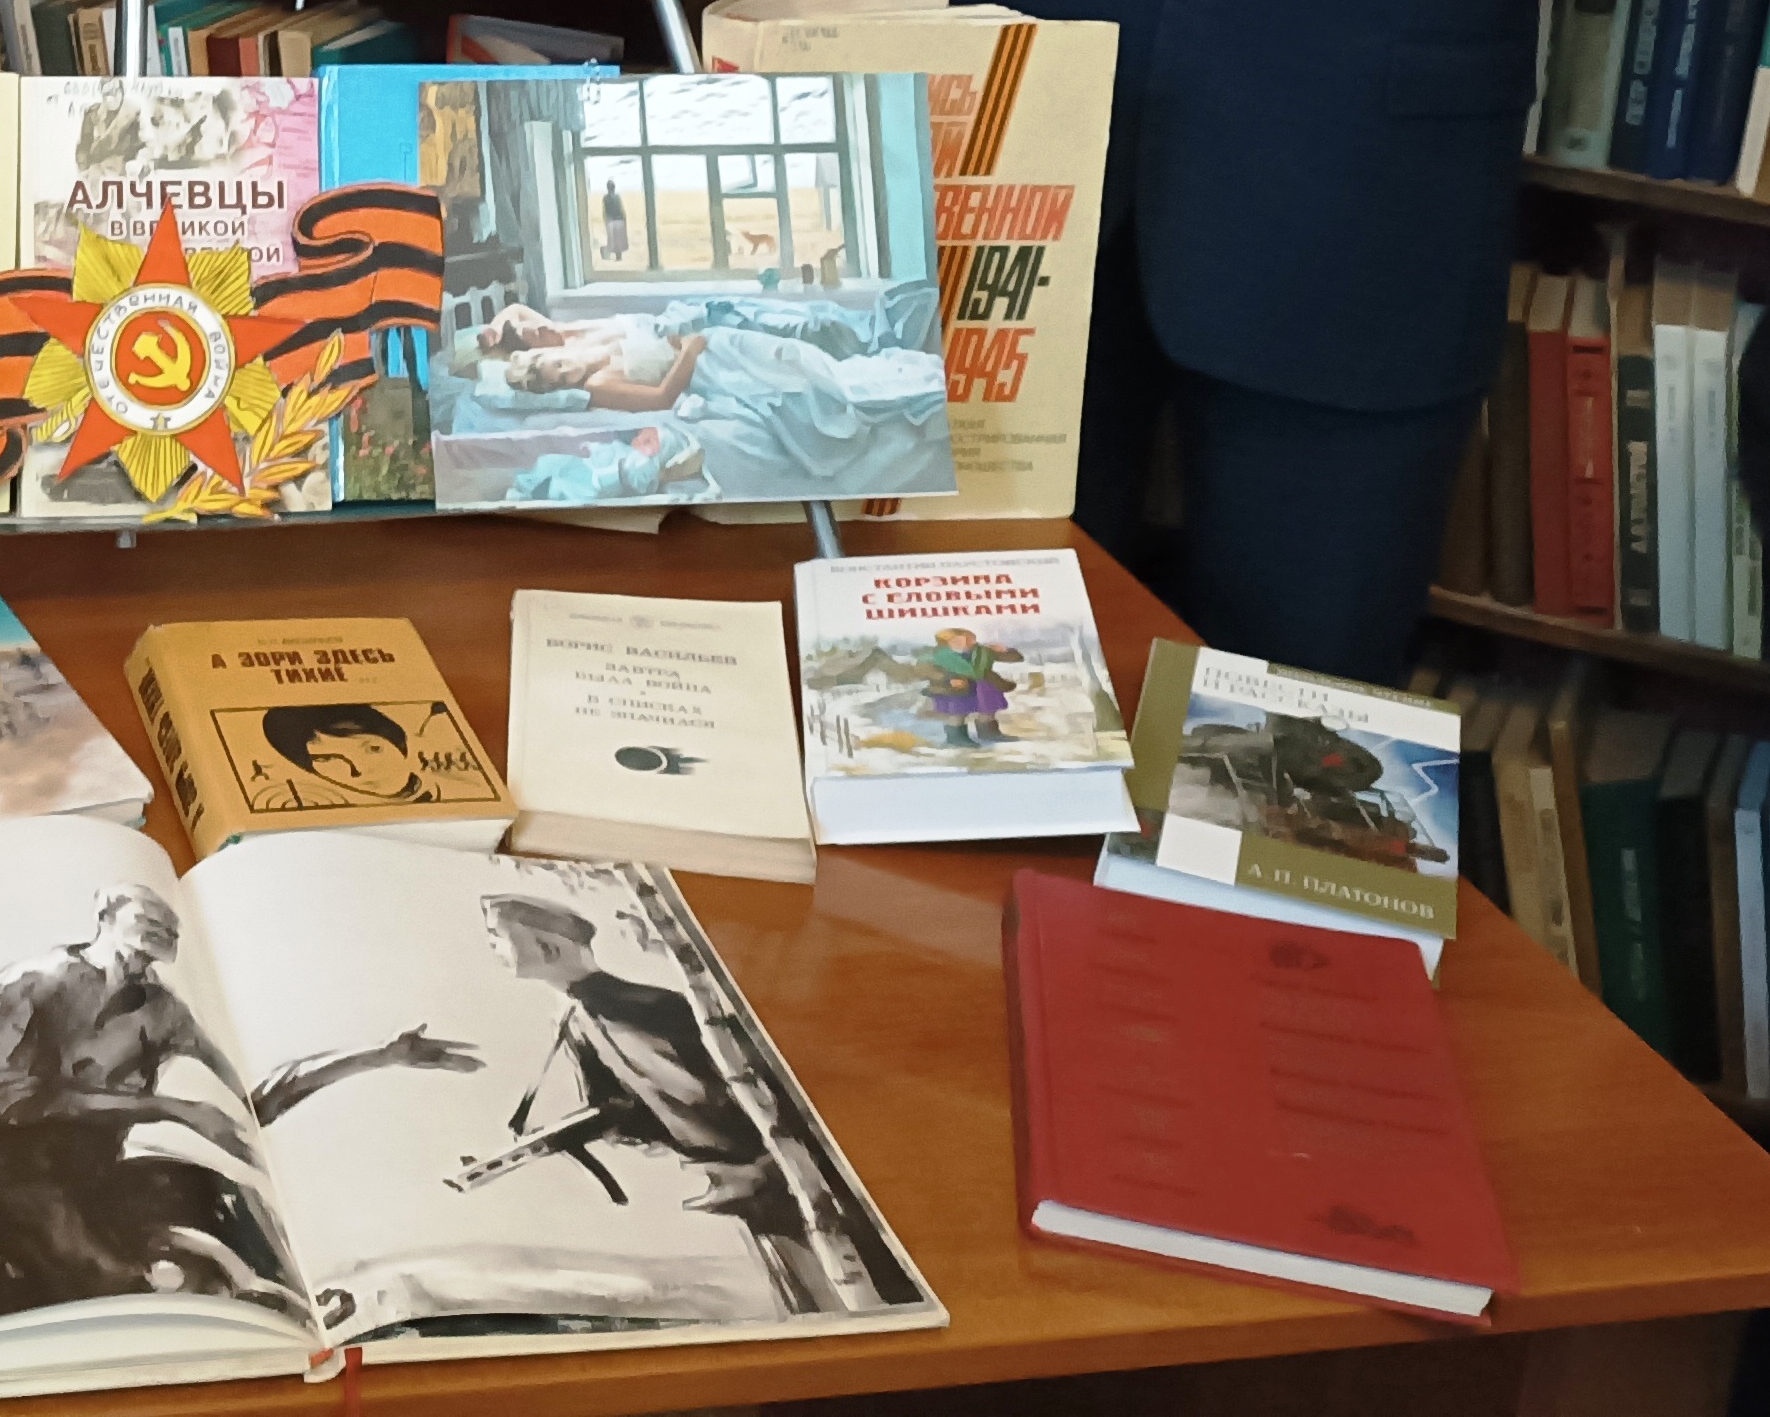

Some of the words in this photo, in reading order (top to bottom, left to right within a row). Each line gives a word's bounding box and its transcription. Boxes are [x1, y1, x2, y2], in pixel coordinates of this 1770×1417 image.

[67, 180, 285, 216] АЛЧЕВЦЫ
[933, 184, 1076, 242] ВЕННОЙ
[132, 218, 246, 237] ВИКОЙ
[946, 327, 1036, 403] 1945
[873, 572, 1014, 591] КОРЗИНА
[865, 602, 1042, 621] ШИШКАМИ
[211, 653, 228, 670] А
[237, 650, 303, 669] ЗОРИ
[313, 648, 396, 666] ЗДЕСЬ
[270, 664, 349, 685] ТИХИЕ
[1303, 875, 1435, 921] ПЛАТОНОВ
